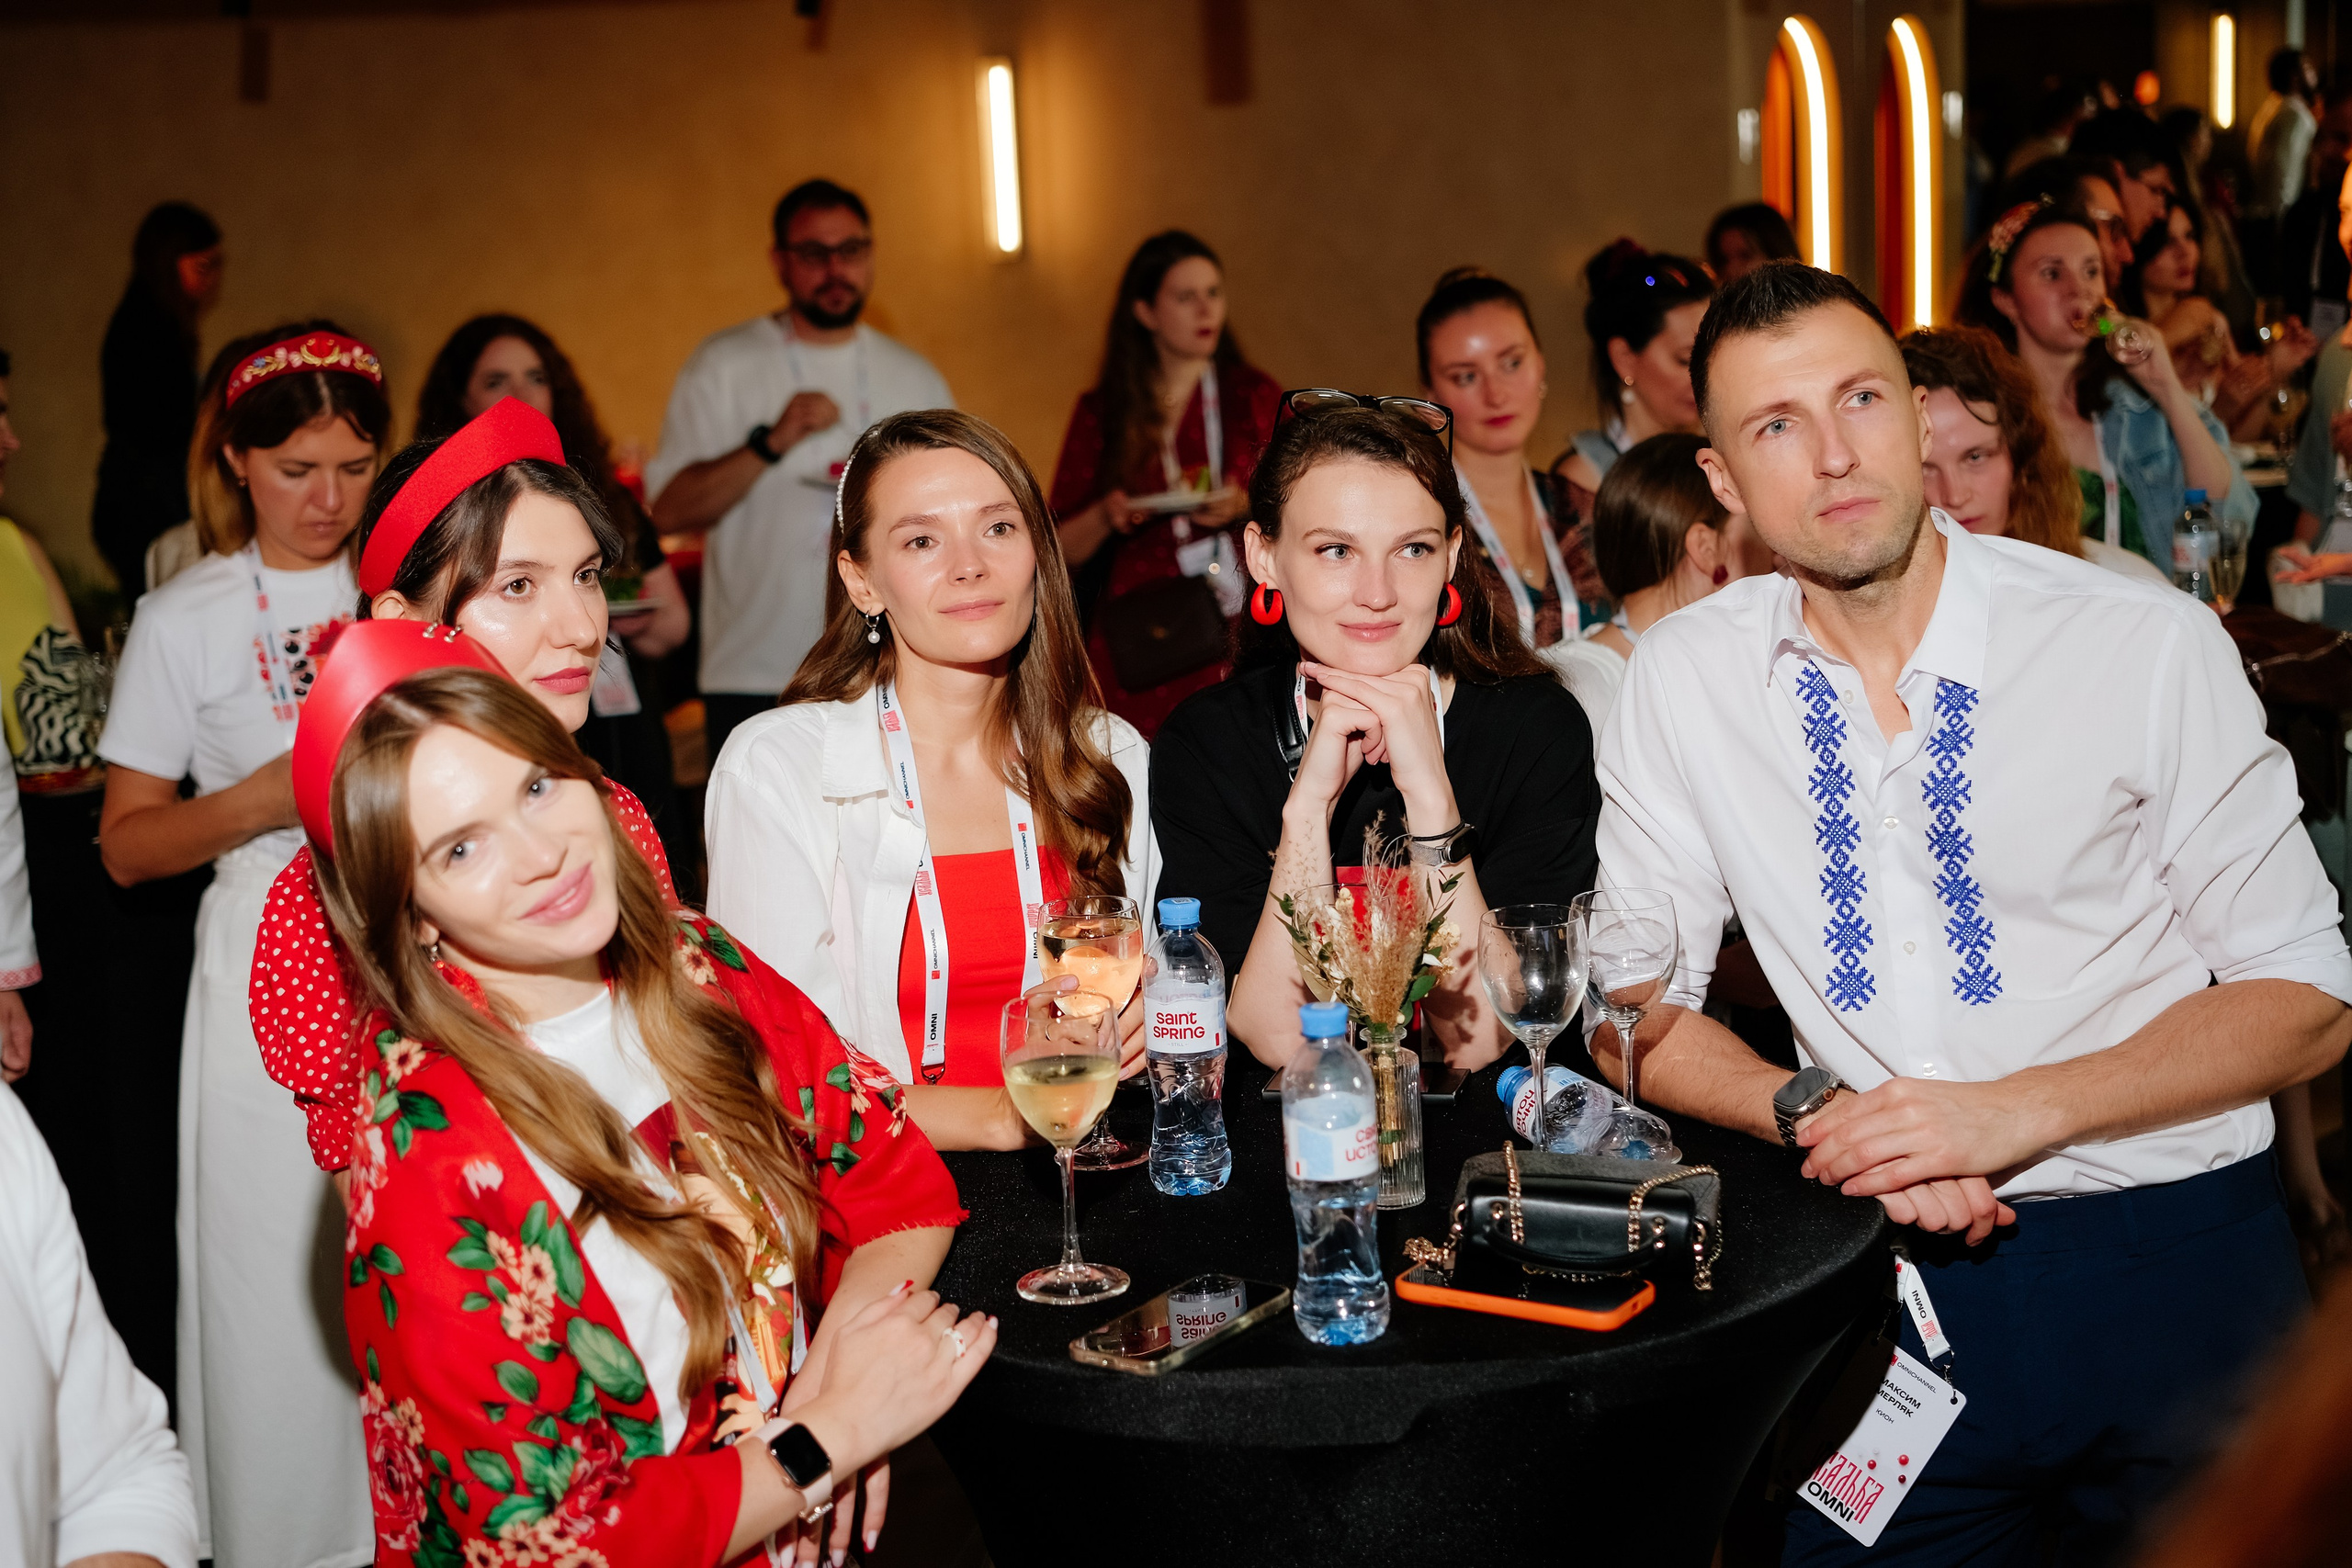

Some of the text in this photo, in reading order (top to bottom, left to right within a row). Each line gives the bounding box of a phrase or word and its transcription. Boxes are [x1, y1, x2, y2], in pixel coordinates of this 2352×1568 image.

[1021, 831, 1031, 871] OMNICHANNEL
[930, 928, 939, 970] OMNICHANNEL
[930, 1012, 938, 1041] OMNI
[1911, 1290, 1927, 1319] OMNI
[1896, 1361, 1937, 1393] OMNICHANNEL
[1875, 1407, 1894, 1425] КИОН
[1807, 1481, 1855, 1523] OMNI
